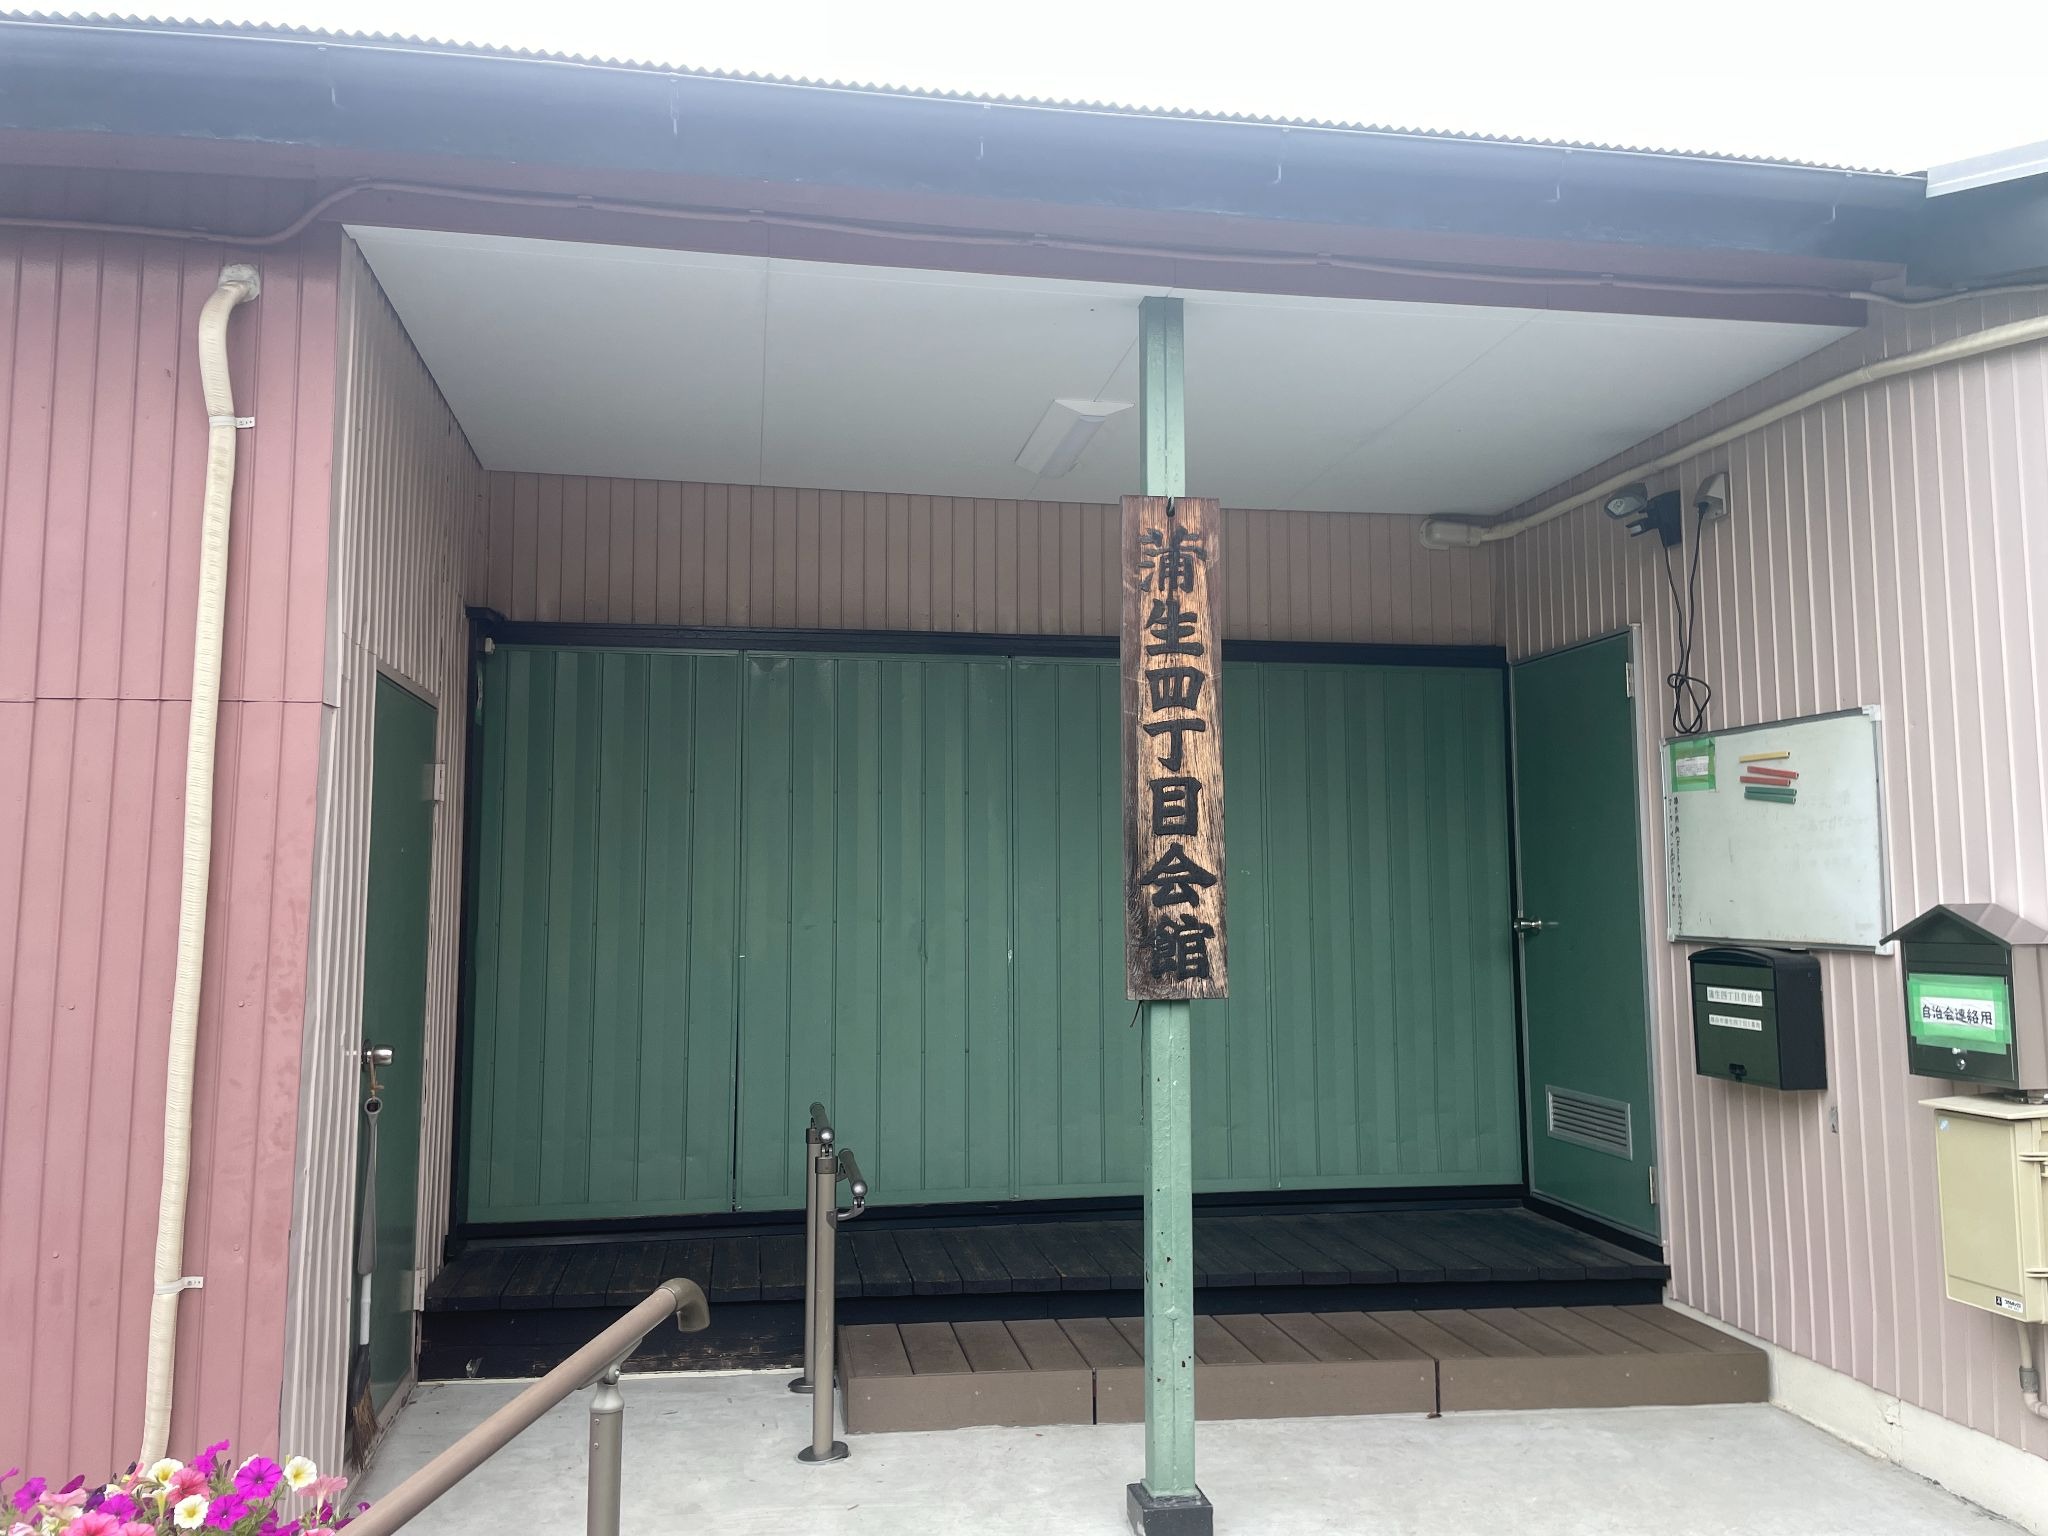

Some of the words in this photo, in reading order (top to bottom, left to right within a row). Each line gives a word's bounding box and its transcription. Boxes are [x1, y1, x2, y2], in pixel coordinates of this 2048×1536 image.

[1138, 525, 1217, 981] 蒲生四丁目会館
[1922, 1004, 1993, 1026] 自治会連絡用
